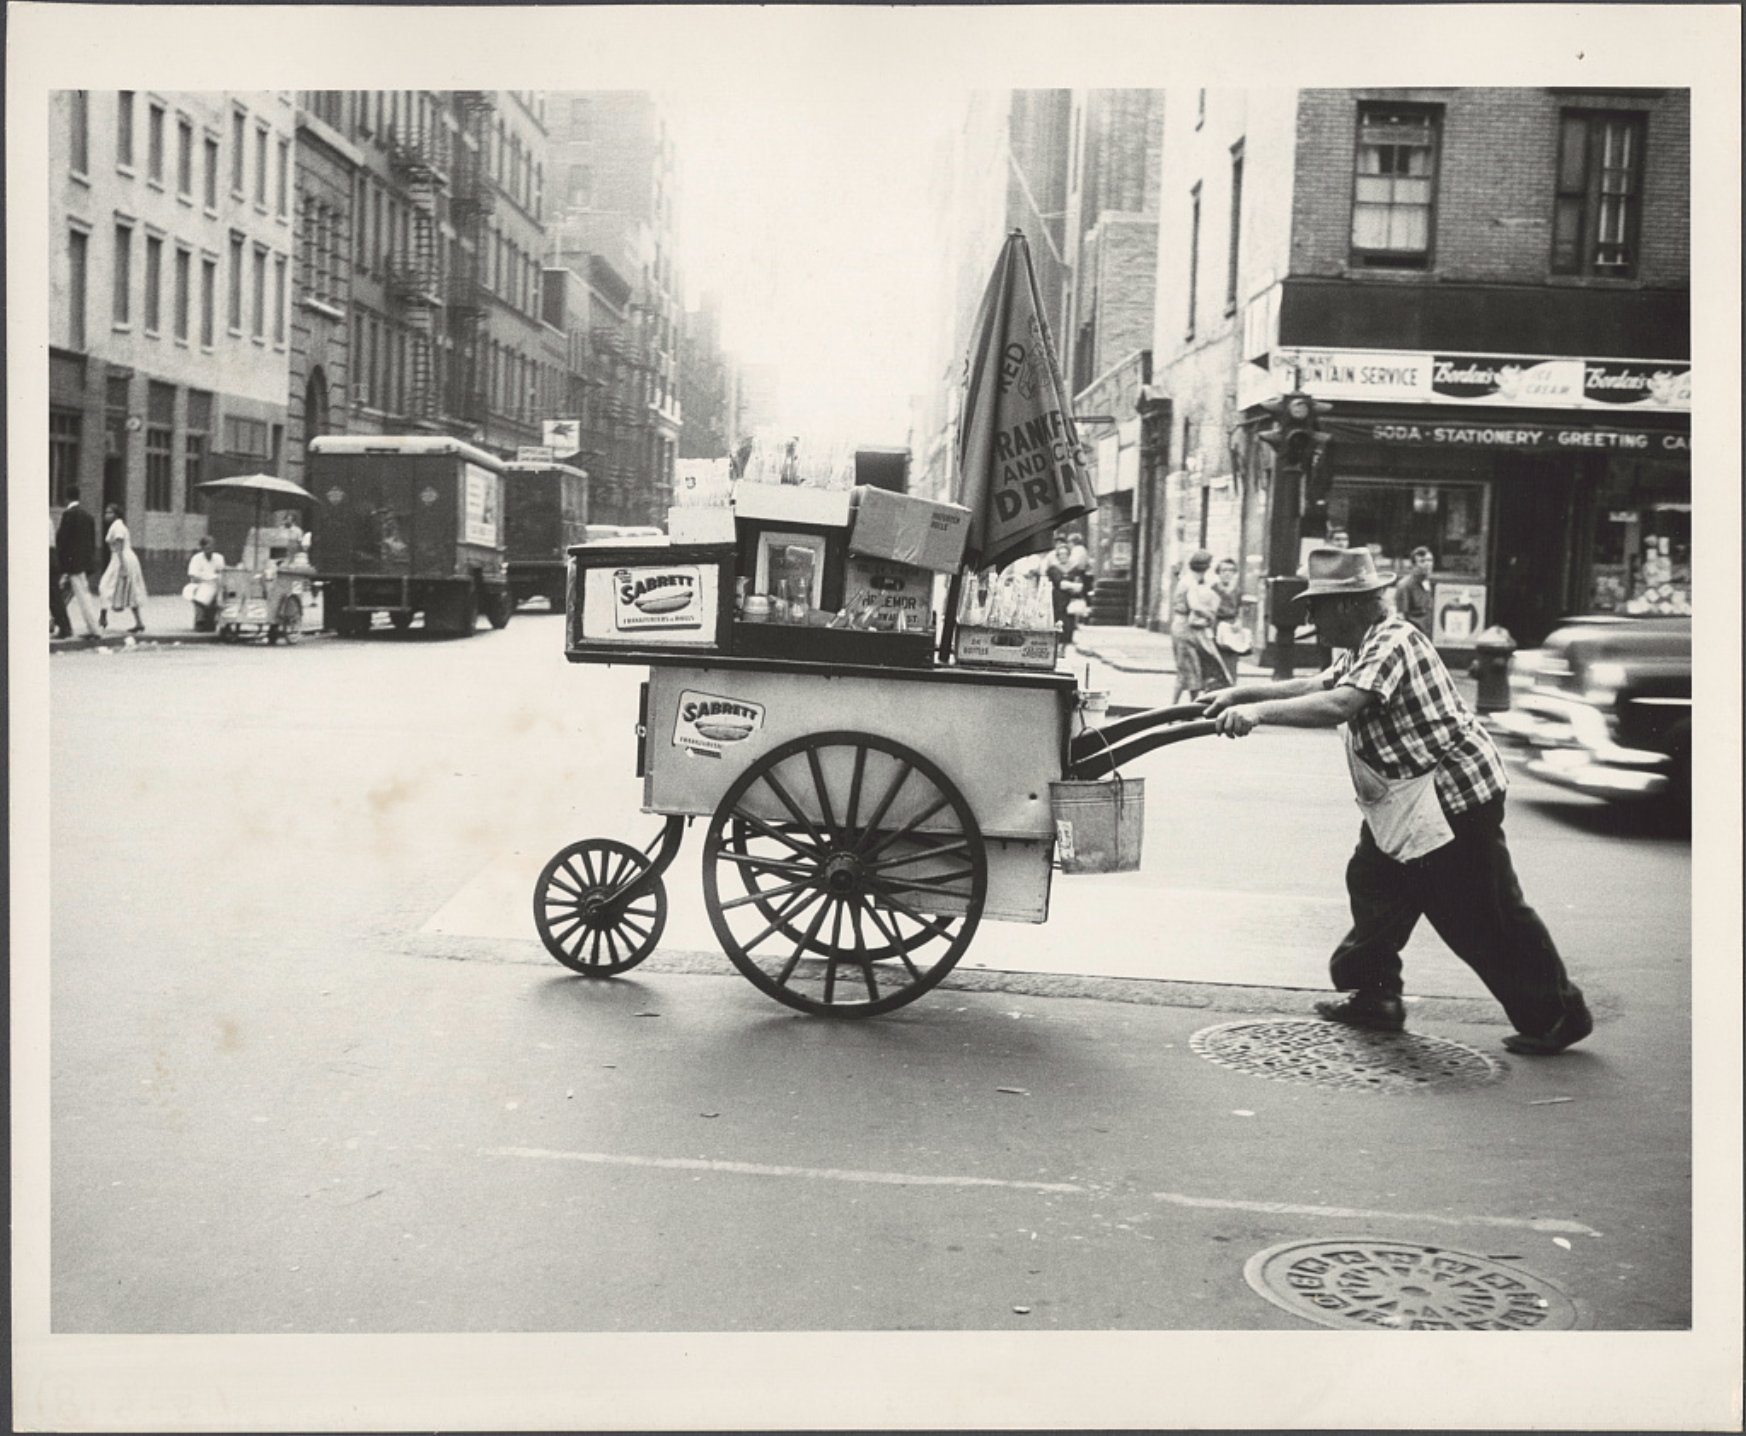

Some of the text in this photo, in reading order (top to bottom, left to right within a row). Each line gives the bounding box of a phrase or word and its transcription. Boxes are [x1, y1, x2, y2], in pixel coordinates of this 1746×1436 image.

[1286, 365, 1418, 386] FUNTAIN SERVICE
[1433, 361, 1494, 384] Borden's
[1585, 367, 1646, 390] Borden's
[1373, 425, 1691, 449] SODA STATIONERY GREETING CA
[1003, 453, 1047, 486] AND
[620, 574, 694, 606] SABRETT
[682, 701, 758, 723] SABRETT
